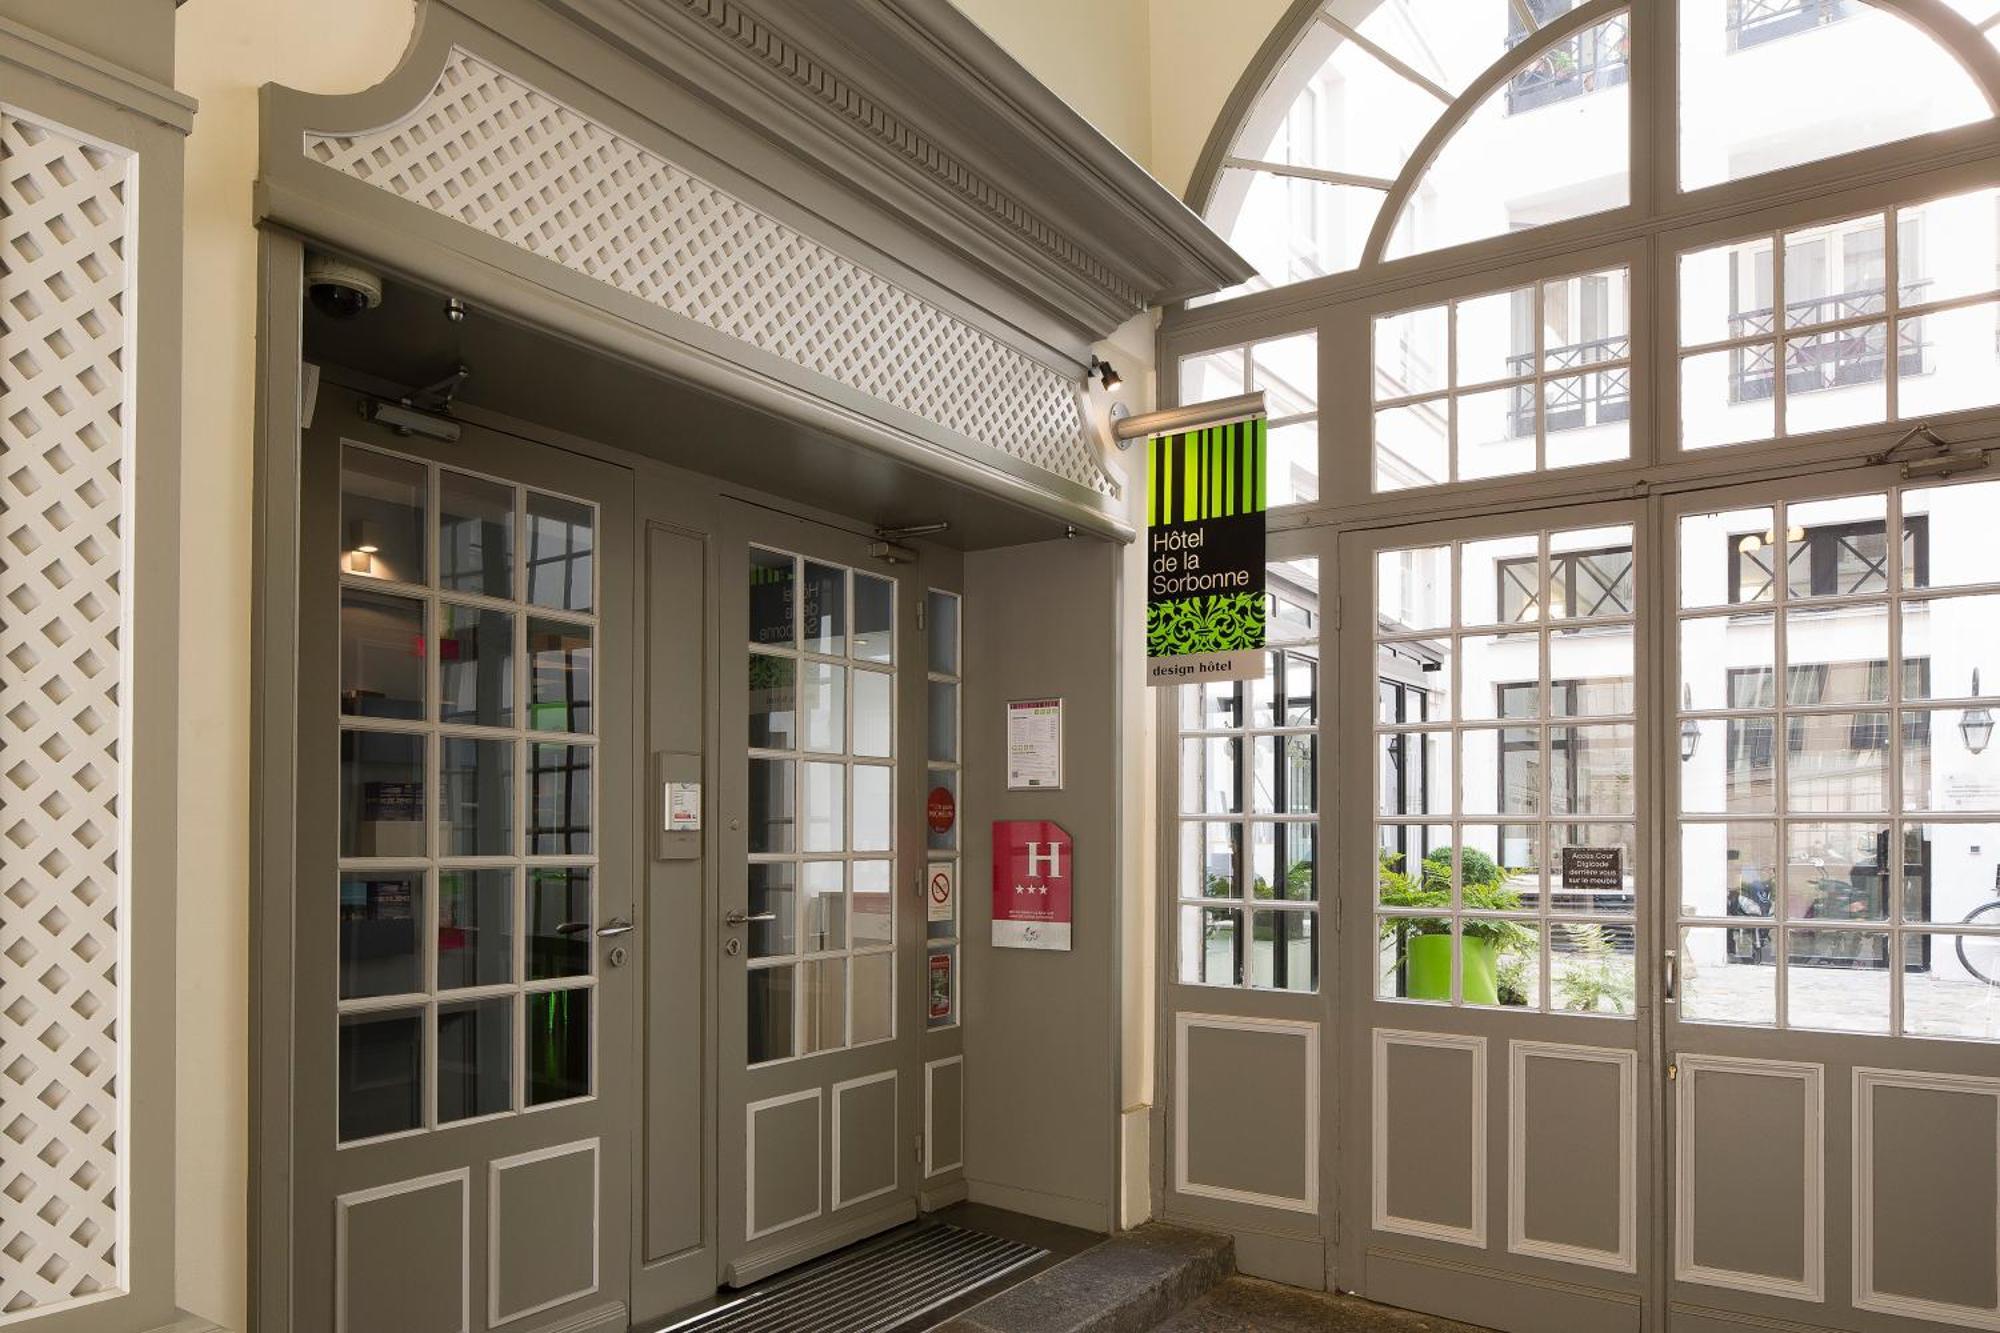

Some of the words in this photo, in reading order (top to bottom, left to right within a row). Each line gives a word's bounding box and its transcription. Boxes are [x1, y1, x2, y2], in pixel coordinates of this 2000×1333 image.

[1153, 527, 1204, 552] Hôtel
[1153, 554, 1177, 574] de
[1183, 551, 1200, 570] la
[1153, 570, 1249, 595] Sorbonne
[1152, 664, 1195, 677] design
[1199, 661, 1232, 673] hôtel
[1025, 841, 1064, 878] H
[1576, 860, 1609, 868] Digicode
[1595, 852, 1614, 860] Cour
[1590, 877, 1618, 885] meuble
